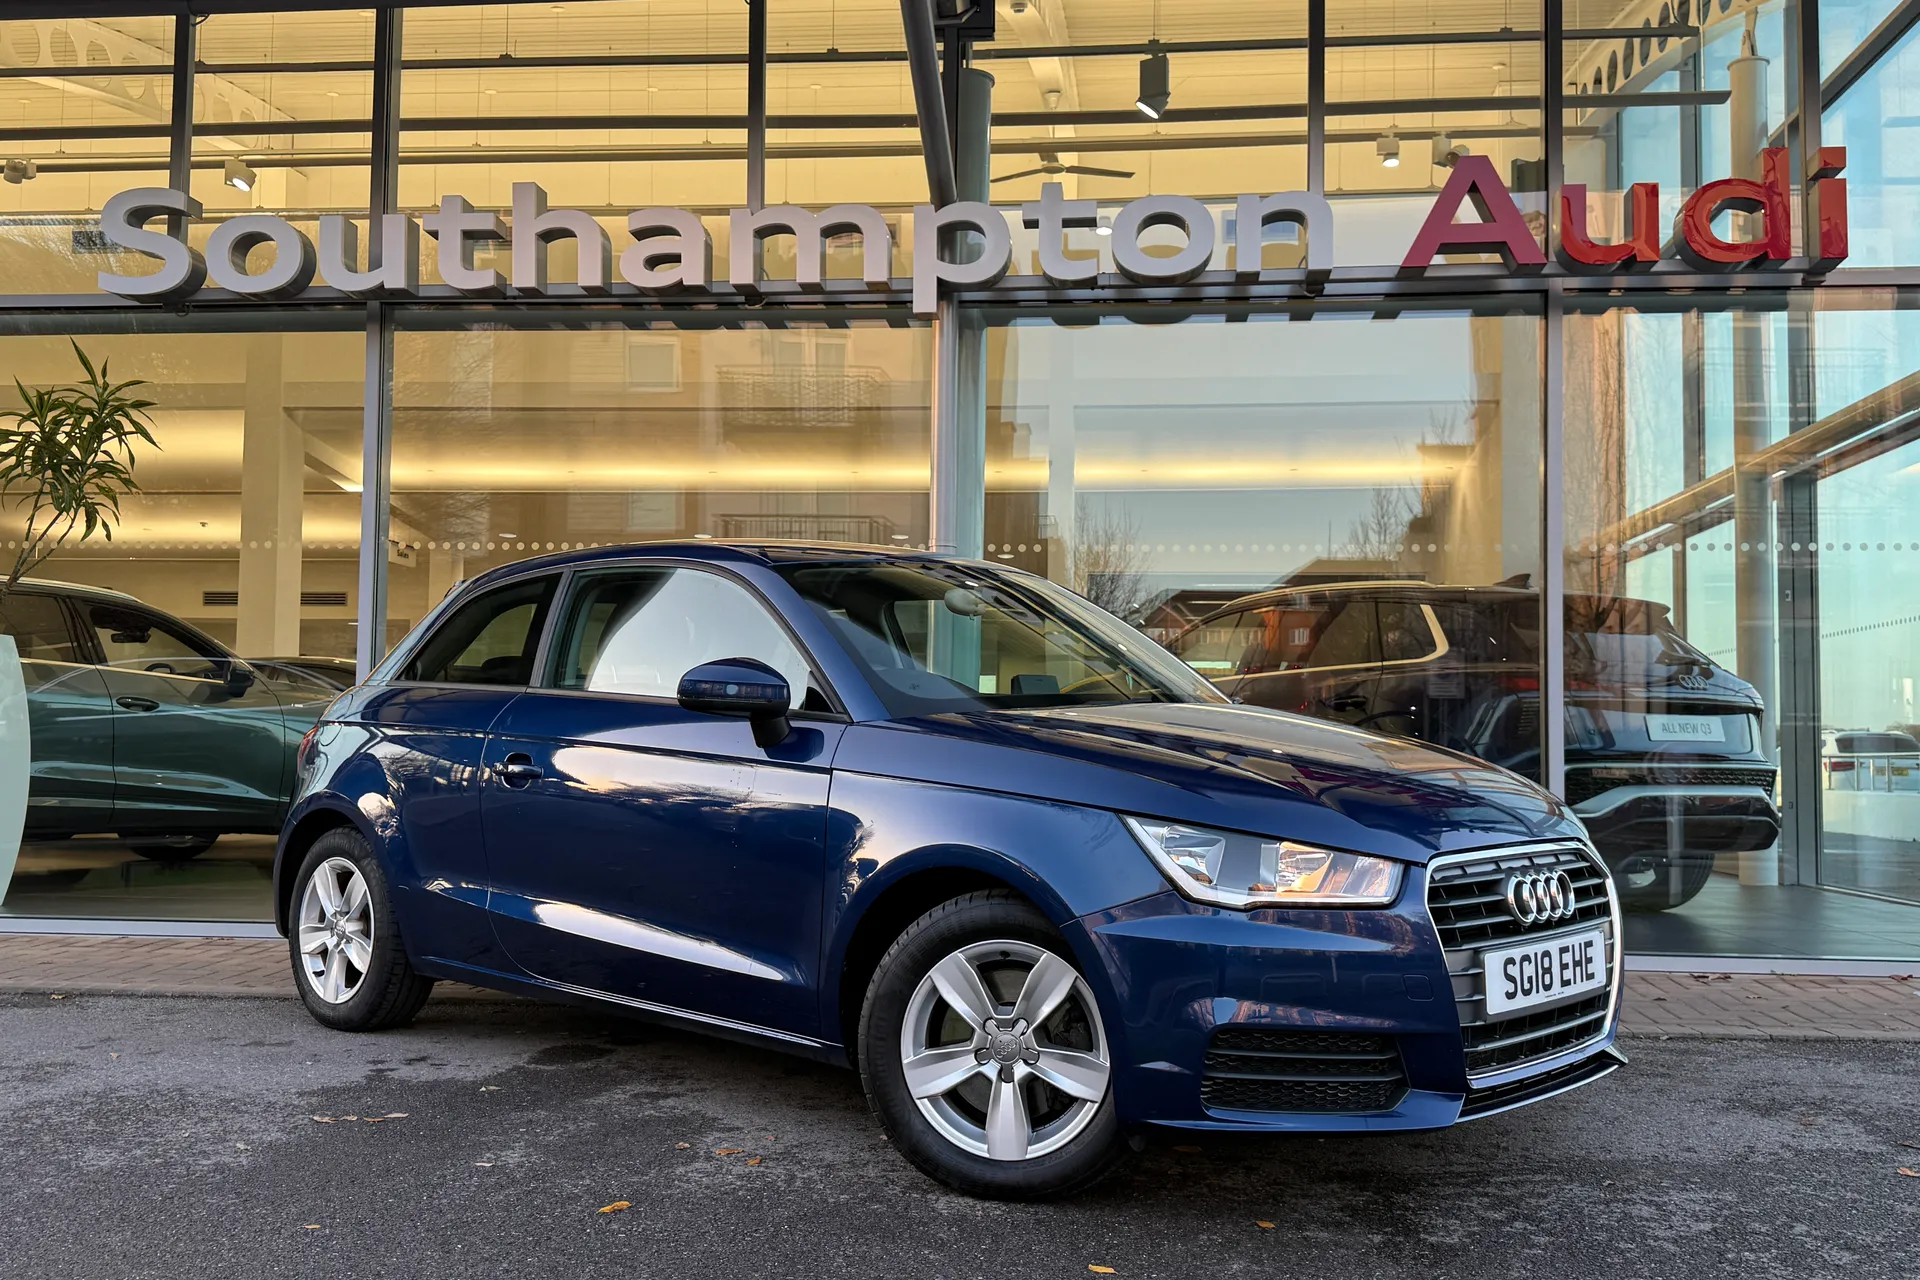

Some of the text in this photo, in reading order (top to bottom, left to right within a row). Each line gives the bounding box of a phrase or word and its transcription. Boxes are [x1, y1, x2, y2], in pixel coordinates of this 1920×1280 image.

[96, 145, 1849, 317] Southampton Audi
[1661, 722, 1712, 736] ALL NEW Q3
[1503, 939, 1596, 1001] SG18 EHE
